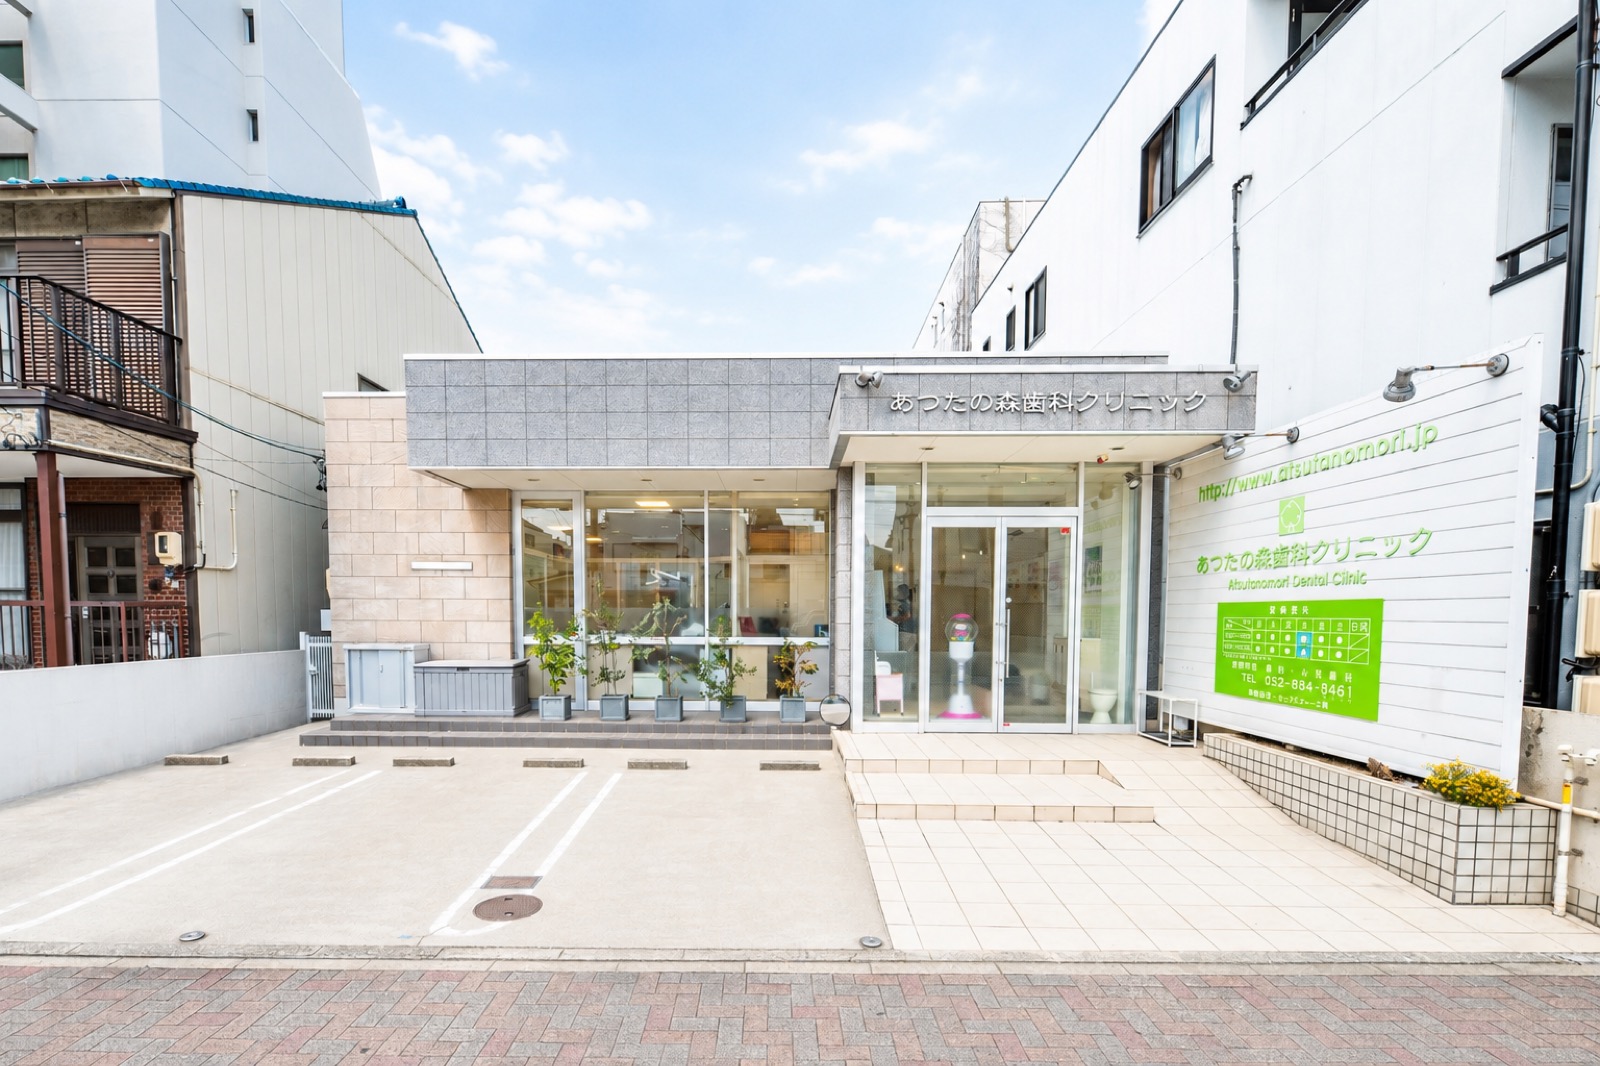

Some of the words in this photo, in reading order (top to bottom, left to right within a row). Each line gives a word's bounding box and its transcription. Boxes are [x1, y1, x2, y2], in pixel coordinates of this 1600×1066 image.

[890, 391, 1207, 413] あつたの森歯科クリニック
[1198, 423, 1438, 503] http://www.atsutanomori.jp
[1196, 527, 1433, 574] あつたの森歯科クリニック
[1292, 573, 1328, 587] Dental
[1241, 673, 1257, 684] TEL
